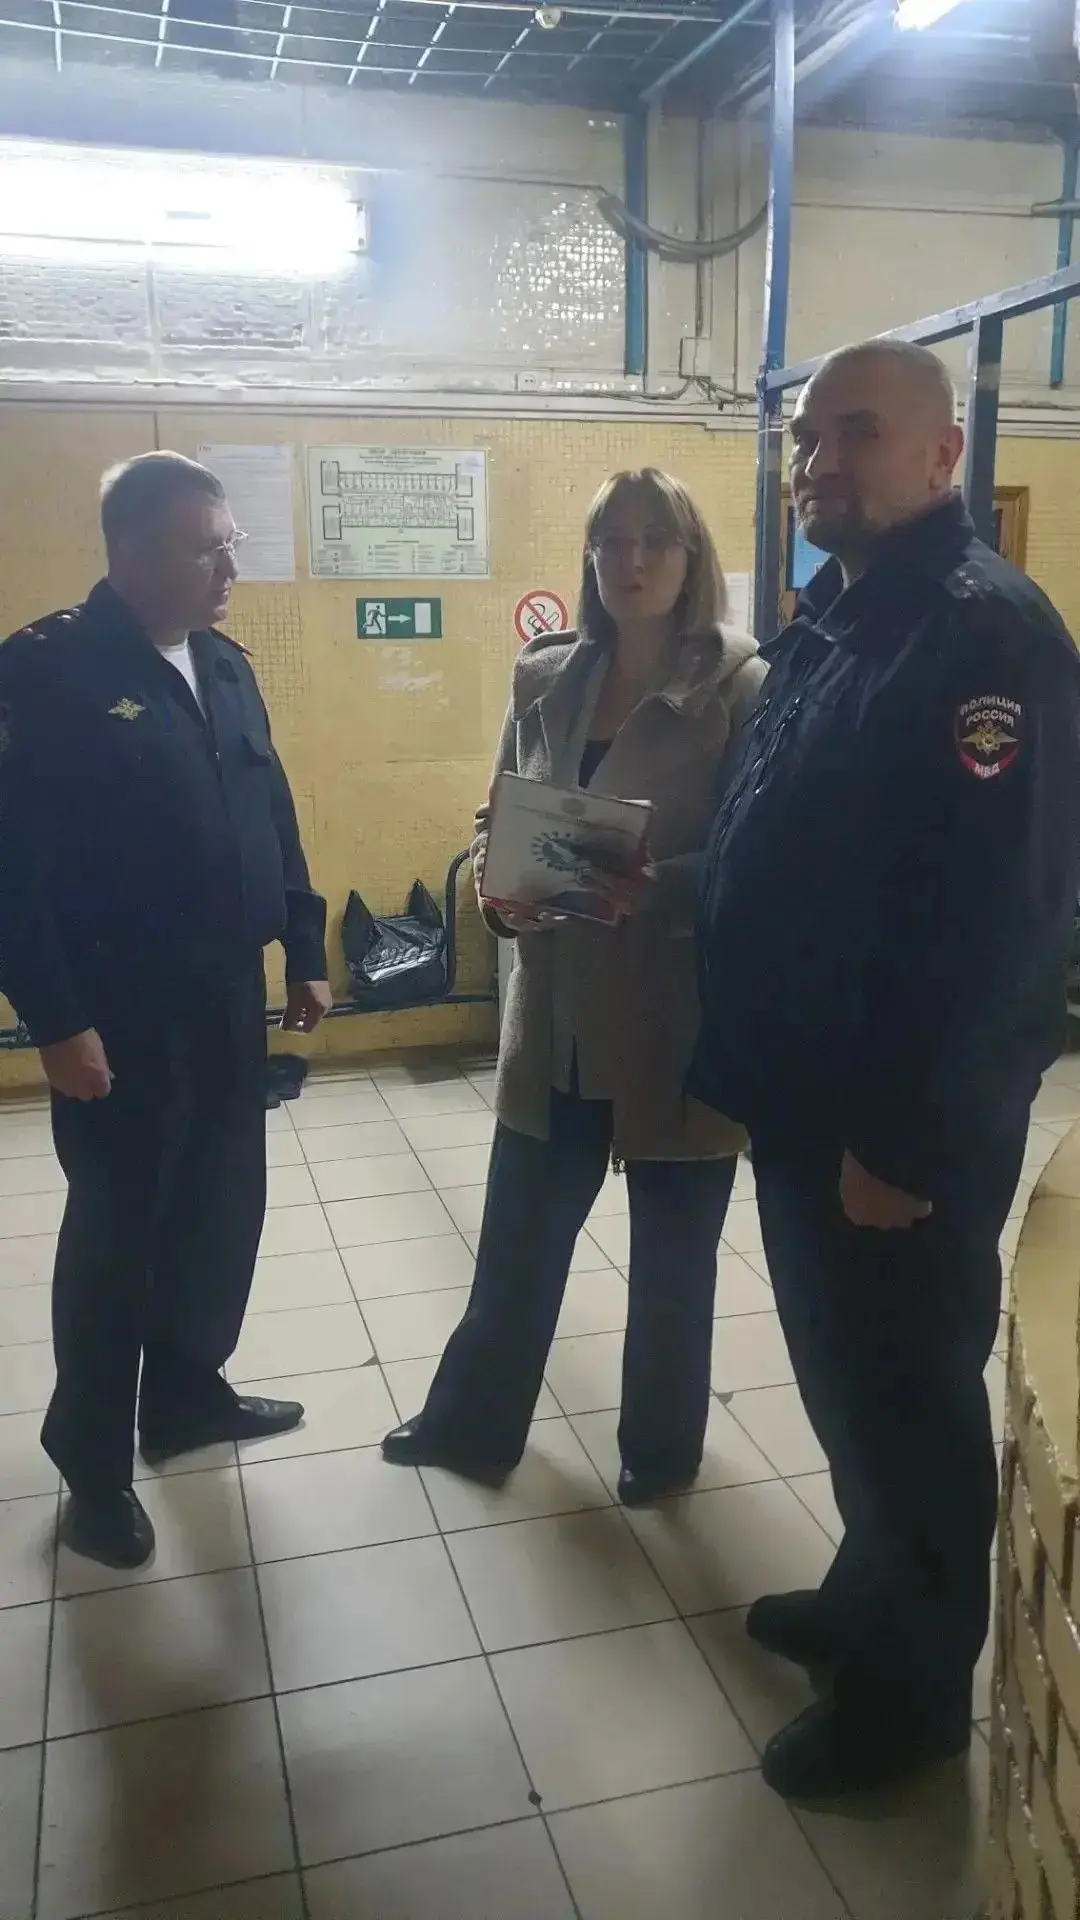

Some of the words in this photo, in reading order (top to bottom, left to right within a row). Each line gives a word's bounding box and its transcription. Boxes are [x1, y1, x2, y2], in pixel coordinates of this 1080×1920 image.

[960, 696, 1022, 716] ПОЛИЦИЯ
[966, 709, 1014, 728] РОССИЯ
[973, 762, 1000, 779] МВД
